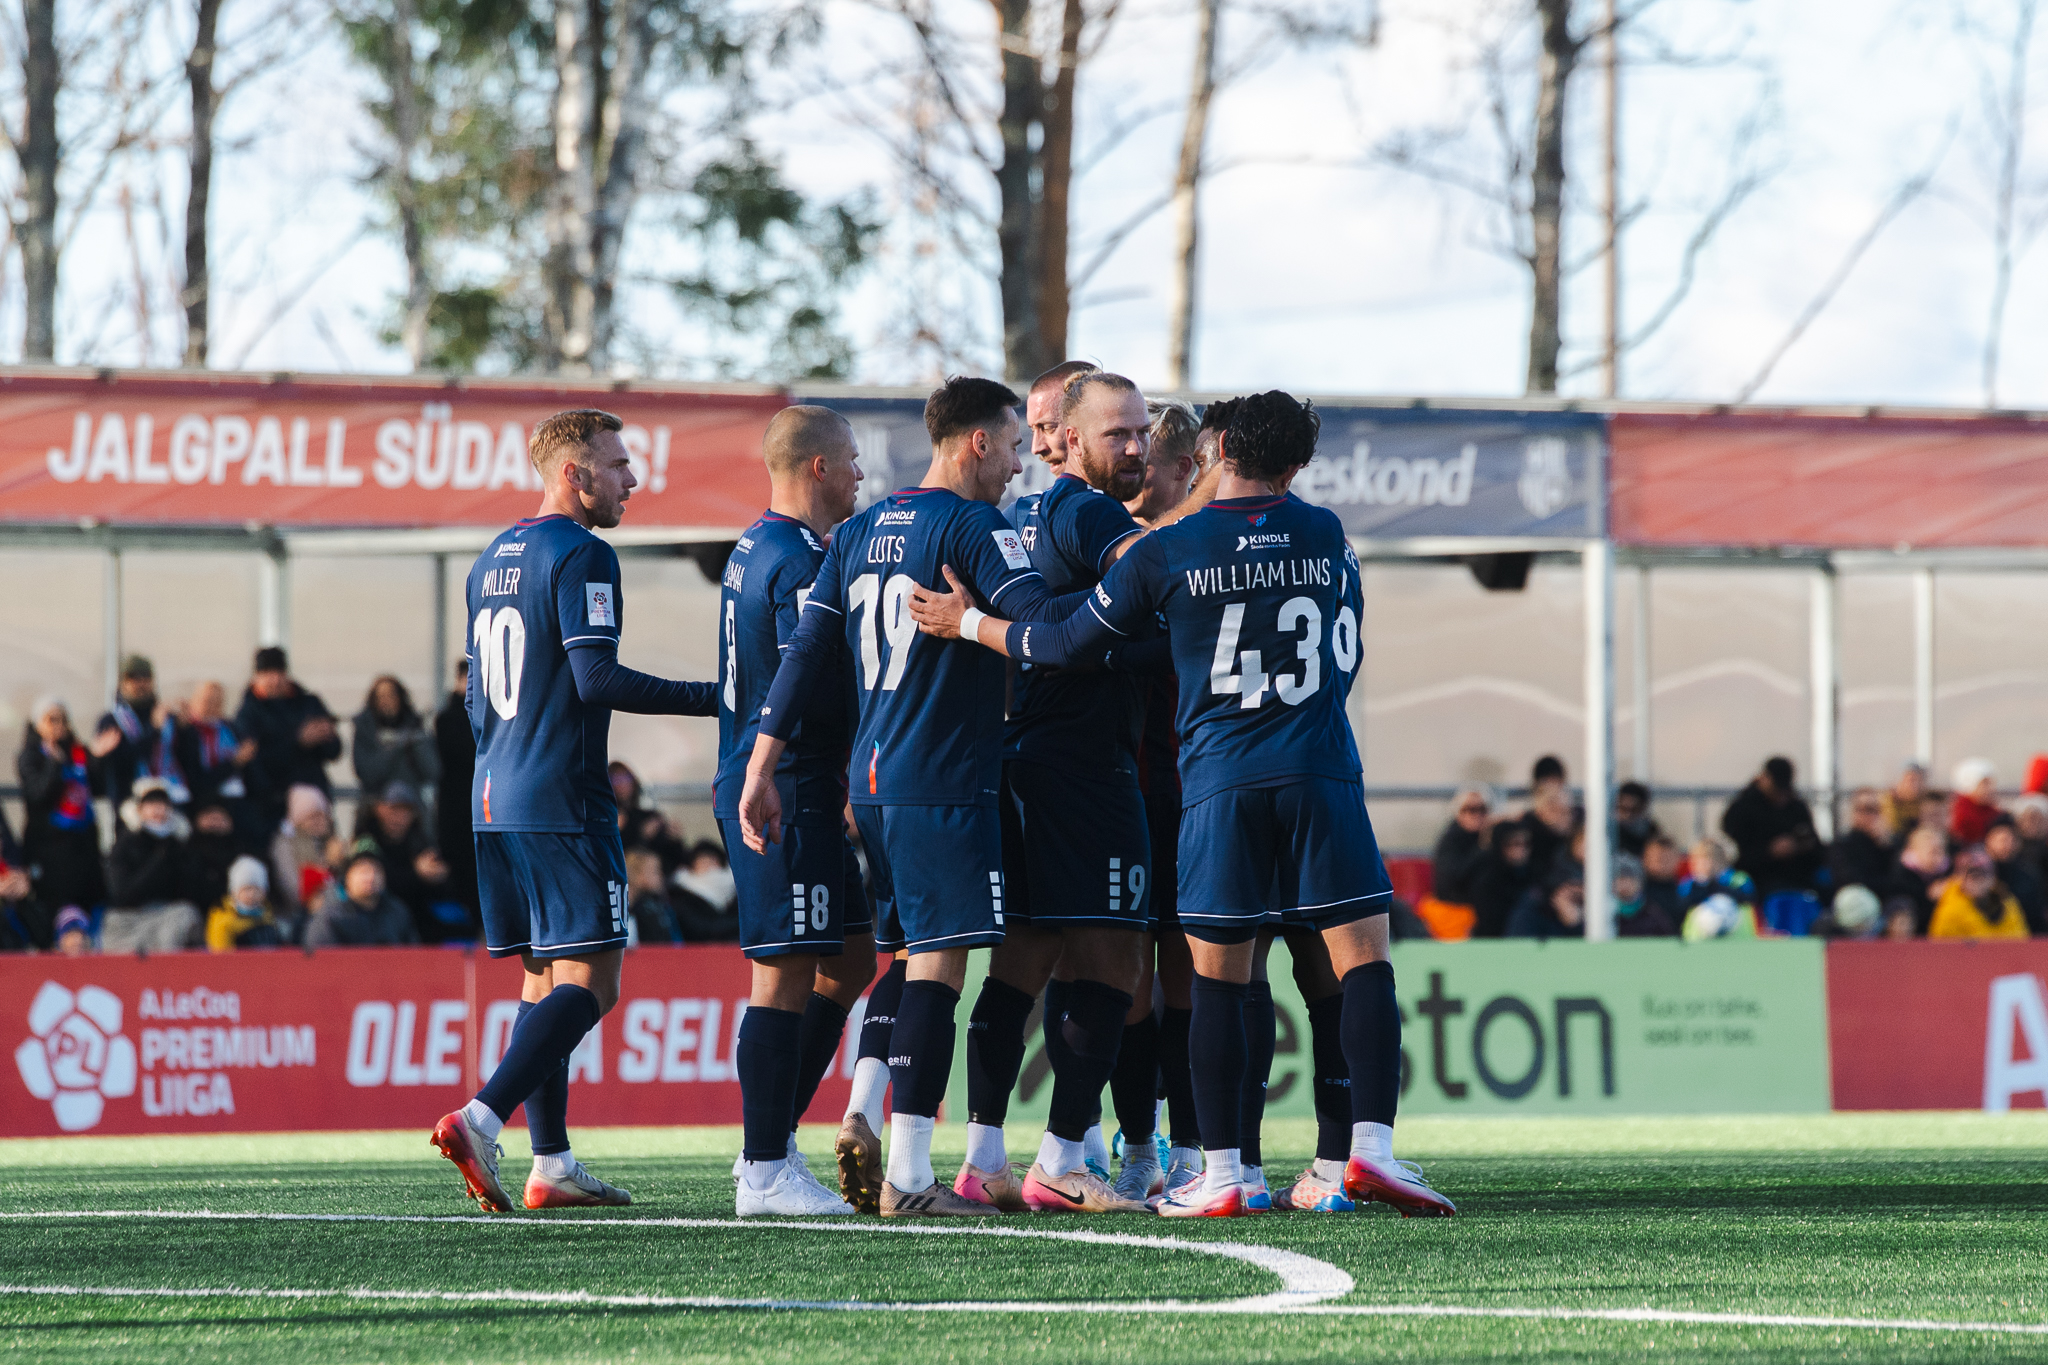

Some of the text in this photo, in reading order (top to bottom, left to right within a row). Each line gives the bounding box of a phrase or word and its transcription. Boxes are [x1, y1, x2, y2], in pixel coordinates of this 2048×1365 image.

[47, 401, 671, 494] JALGPALL SÜDAS!
[1298, 441, 1477, 505] eskond
[885, 510, 917, 520] KINDLE
[1249, 533, 1290, 544] KINDLE
[867, 535, 906, 563] LUTS
[481, 567, 521, 597] MILLER
[1186, 557, 1331, 597] WILLIAM LINS
[848, 573, 919, 691] 19
[1211, 596, 1322, 709] 43
[473, 605, 526, 721] 10
[811, 884, 830, 931] 8
[1127, 864, 1146, 911] 9
[141, 1025, 317, 1070] PREMIUM
[345, 1000, 469, 1087] OLE
[478, 998, 605, 1085] OA
[142, 1072, 236, 1117] LIIGA
